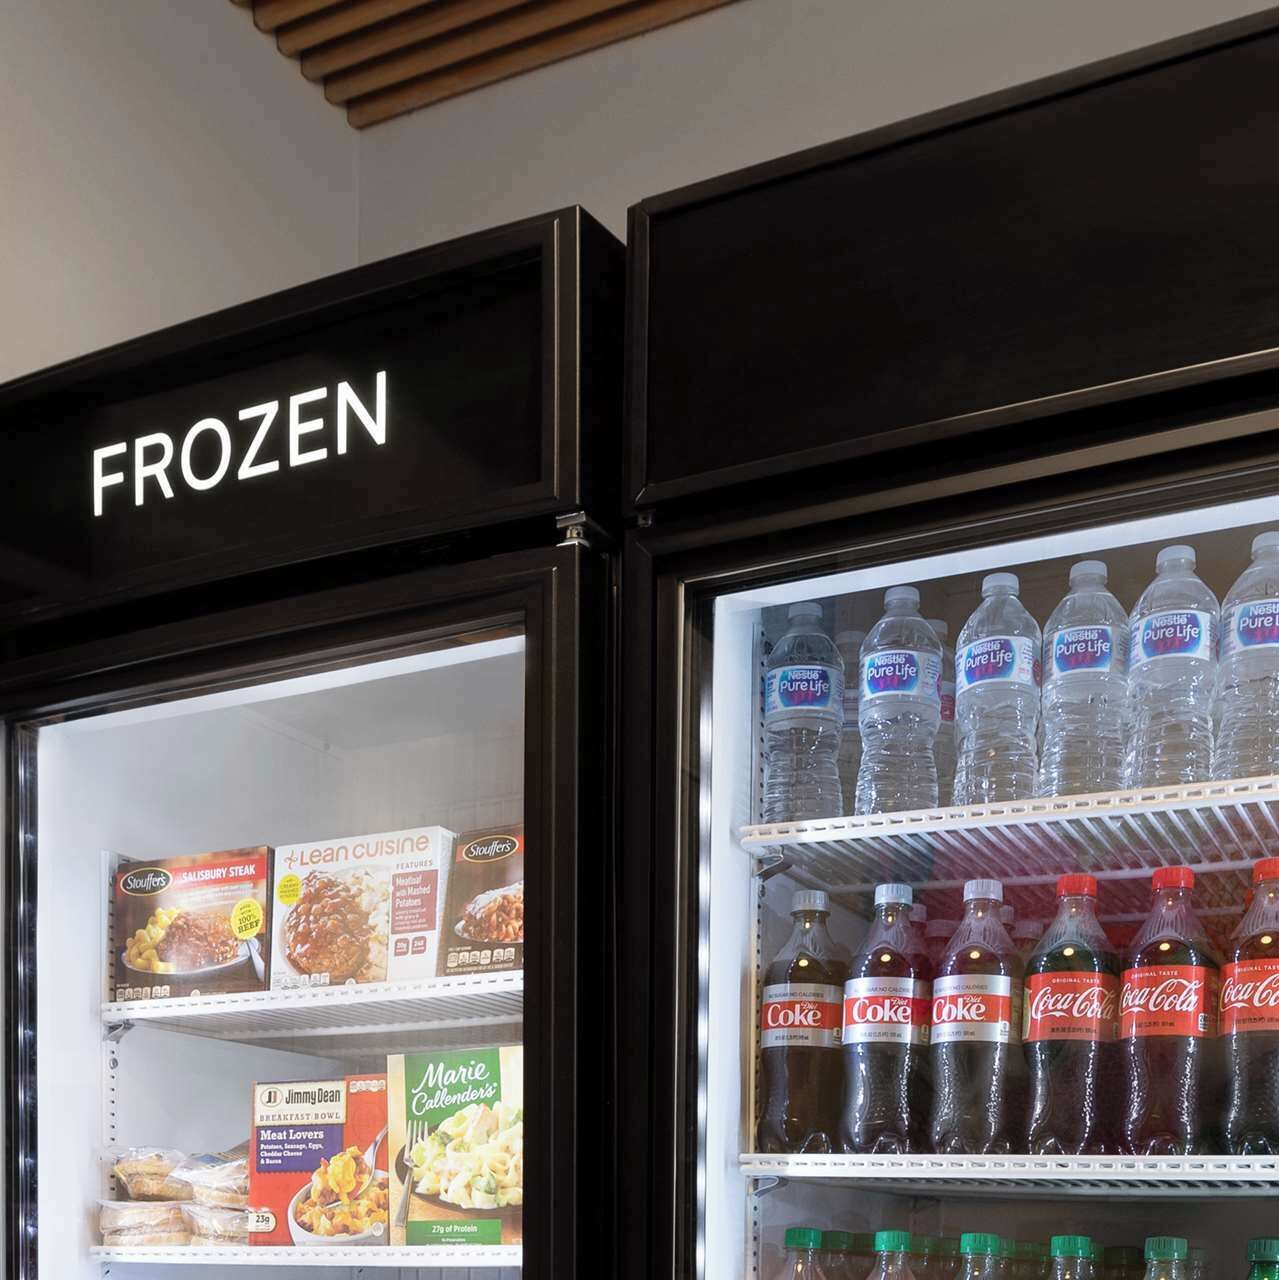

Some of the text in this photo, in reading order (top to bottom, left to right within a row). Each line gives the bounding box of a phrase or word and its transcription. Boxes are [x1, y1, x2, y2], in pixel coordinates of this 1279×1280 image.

[94, 370, 386, 517] FROZEN
[1143, 624, 1200, 642] Pure Life
[1056, 640, 1111, 656] Pure Life
[470, 842, 512, 857] Stouffer's
[182, 864, 255, 881] SALISBURY STEAK
[396, 860, 433, 870] FEATURES
[127, 874, 166, 890] Stouffer's
[238, 919, 260, 933] BEEF
[852, 999, 911, 1024] Coke
[933, 997, 985, 1022] Coke
[1031, 986, 1115, 1022] Coca-Cola
[768, 1003, 821, 1027] Coke
[412, 1060, 489, 1094] Marie
[286, 1088, 340, 1104] Jimmy Dean
[412, 1083, 496, 1115] Callender's
[260, 1114, 310, 1122] BREAKFAST
[261, 1130, 324, 1140] Meat Lovers
[256, 1215, 270, 1224] 23g
[432, 1225, 478, 1234] 27g of Protein
